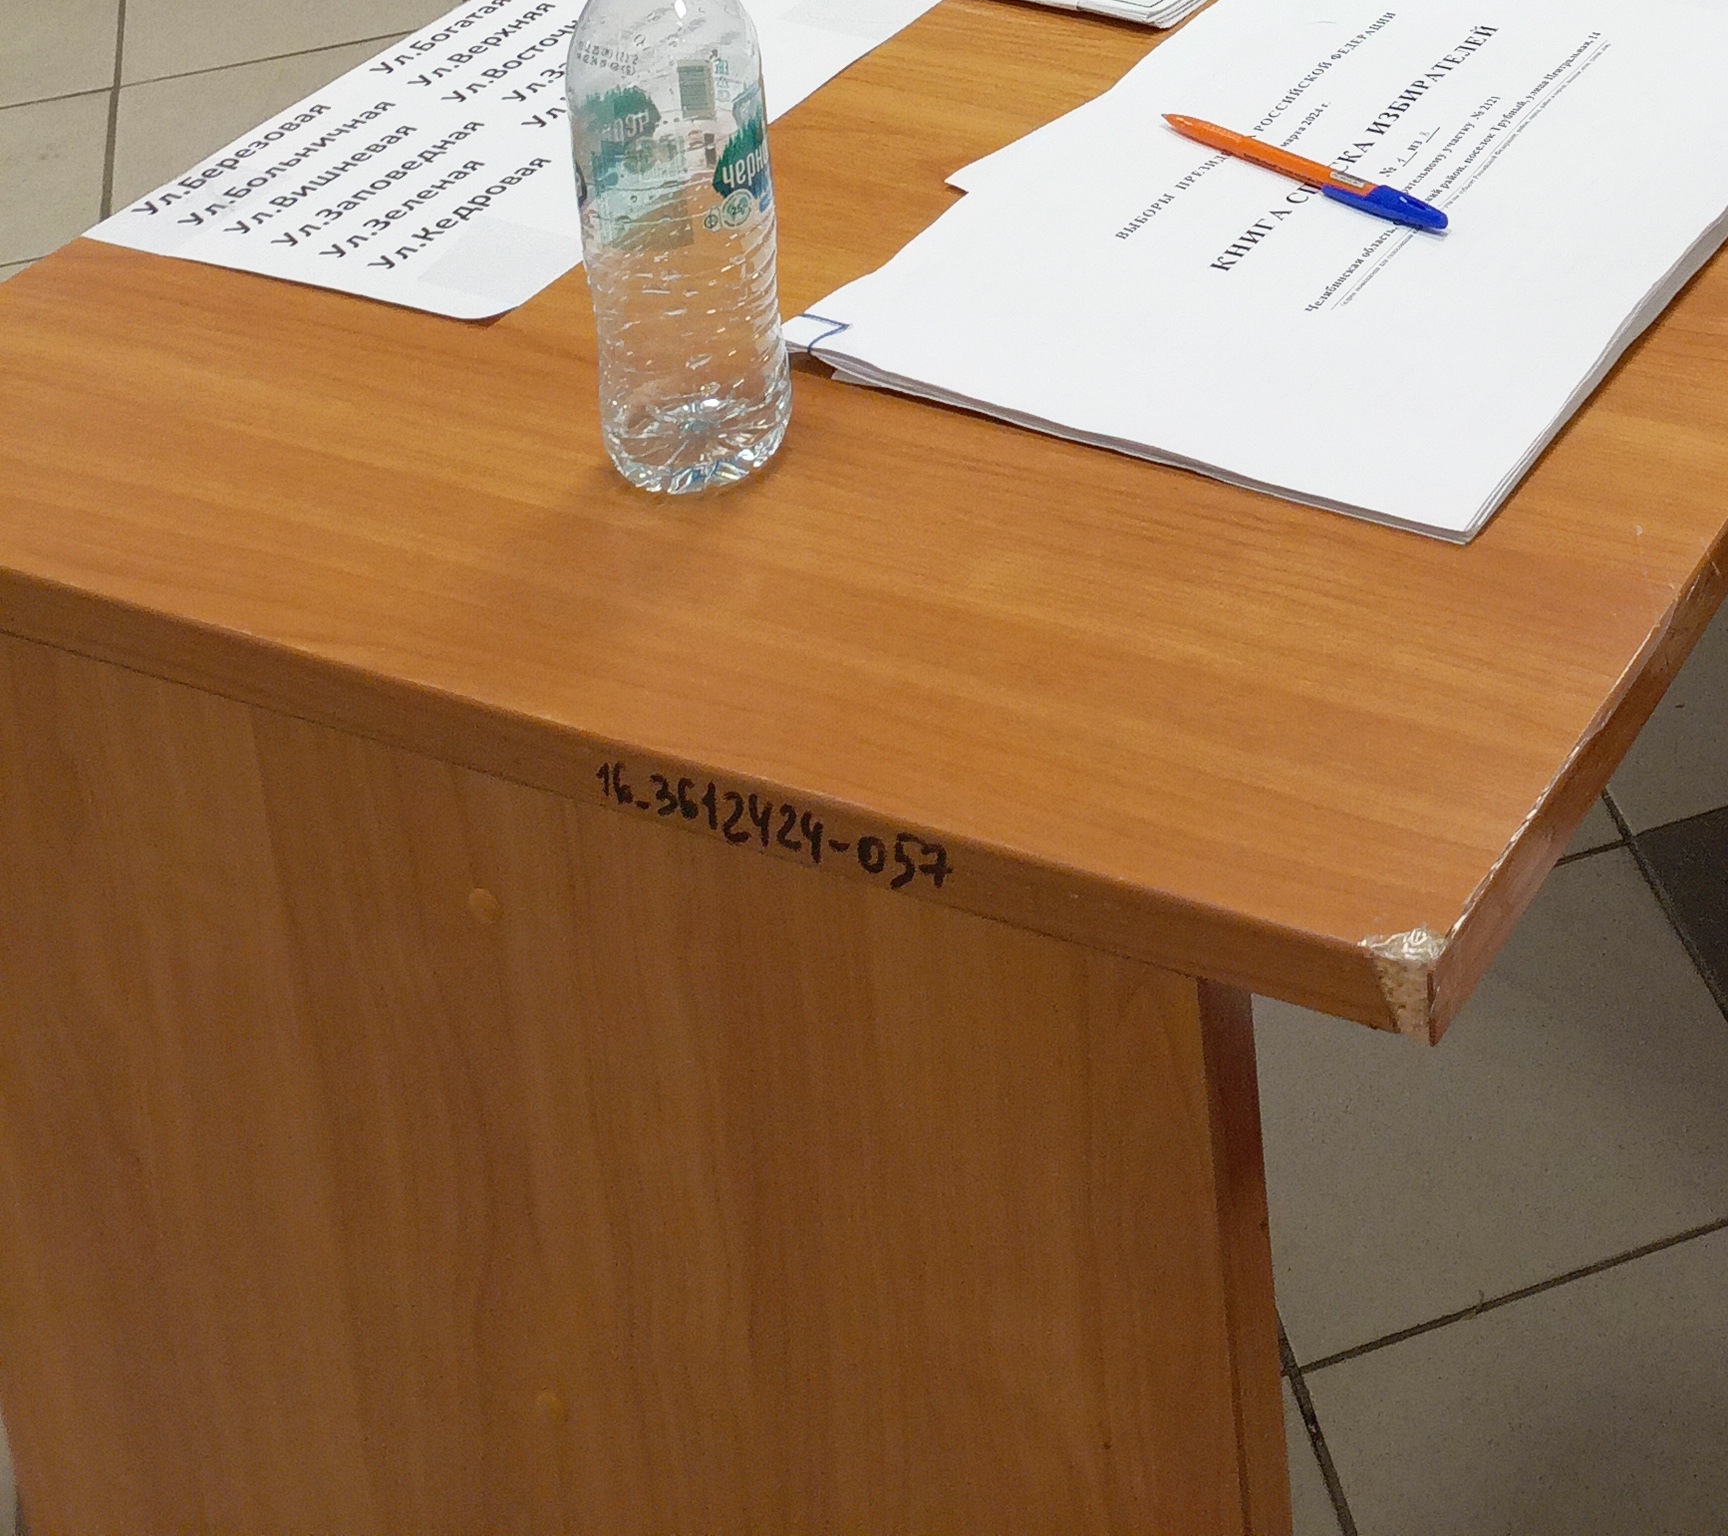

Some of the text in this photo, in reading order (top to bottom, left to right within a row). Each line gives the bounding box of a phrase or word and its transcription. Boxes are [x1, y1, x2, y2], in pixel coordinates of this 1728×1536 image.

[132, 100, 332, 217] Ул.Березовая
[177, 0, 557, 229] Ул.Больничная Ул.Верхняя
[1113, 191, 1176, 241] ВЫБОРЫ
[1252, 58, 1333, 132] РОССИЙСКОЙ
[1328, 10, 1397, 61] ФЕДЕРАЦИИ
[1208, 21, 1500, 273] КНИГА СПСКА ИЗБИРАТЕЛЕЙ
[1299, 106, 1325, 127] 2024
[1378, 164, 1398, 178] №
[1406, 138, 1423, 151] из
[1441, 120, 1476, 154] участку
[1470, 106, 1487, 121] №
[223, 123, 419, 238] Ул.Вишневая
[271, 118, 487, 250] Ул.Заповедная
[318, 158, 487, 261] Ул.Зеленая
[367, 155, 553, 272] Ул.Кедровая
[1304, 257, 1364, 313] Челябинская
[1359, 225, 1399, 258] область,
[1464, 131, 1495, 163] поселок
[1489, 97, 1530, 134] Трубный,
[1527, 79, 1549, 102] улица
